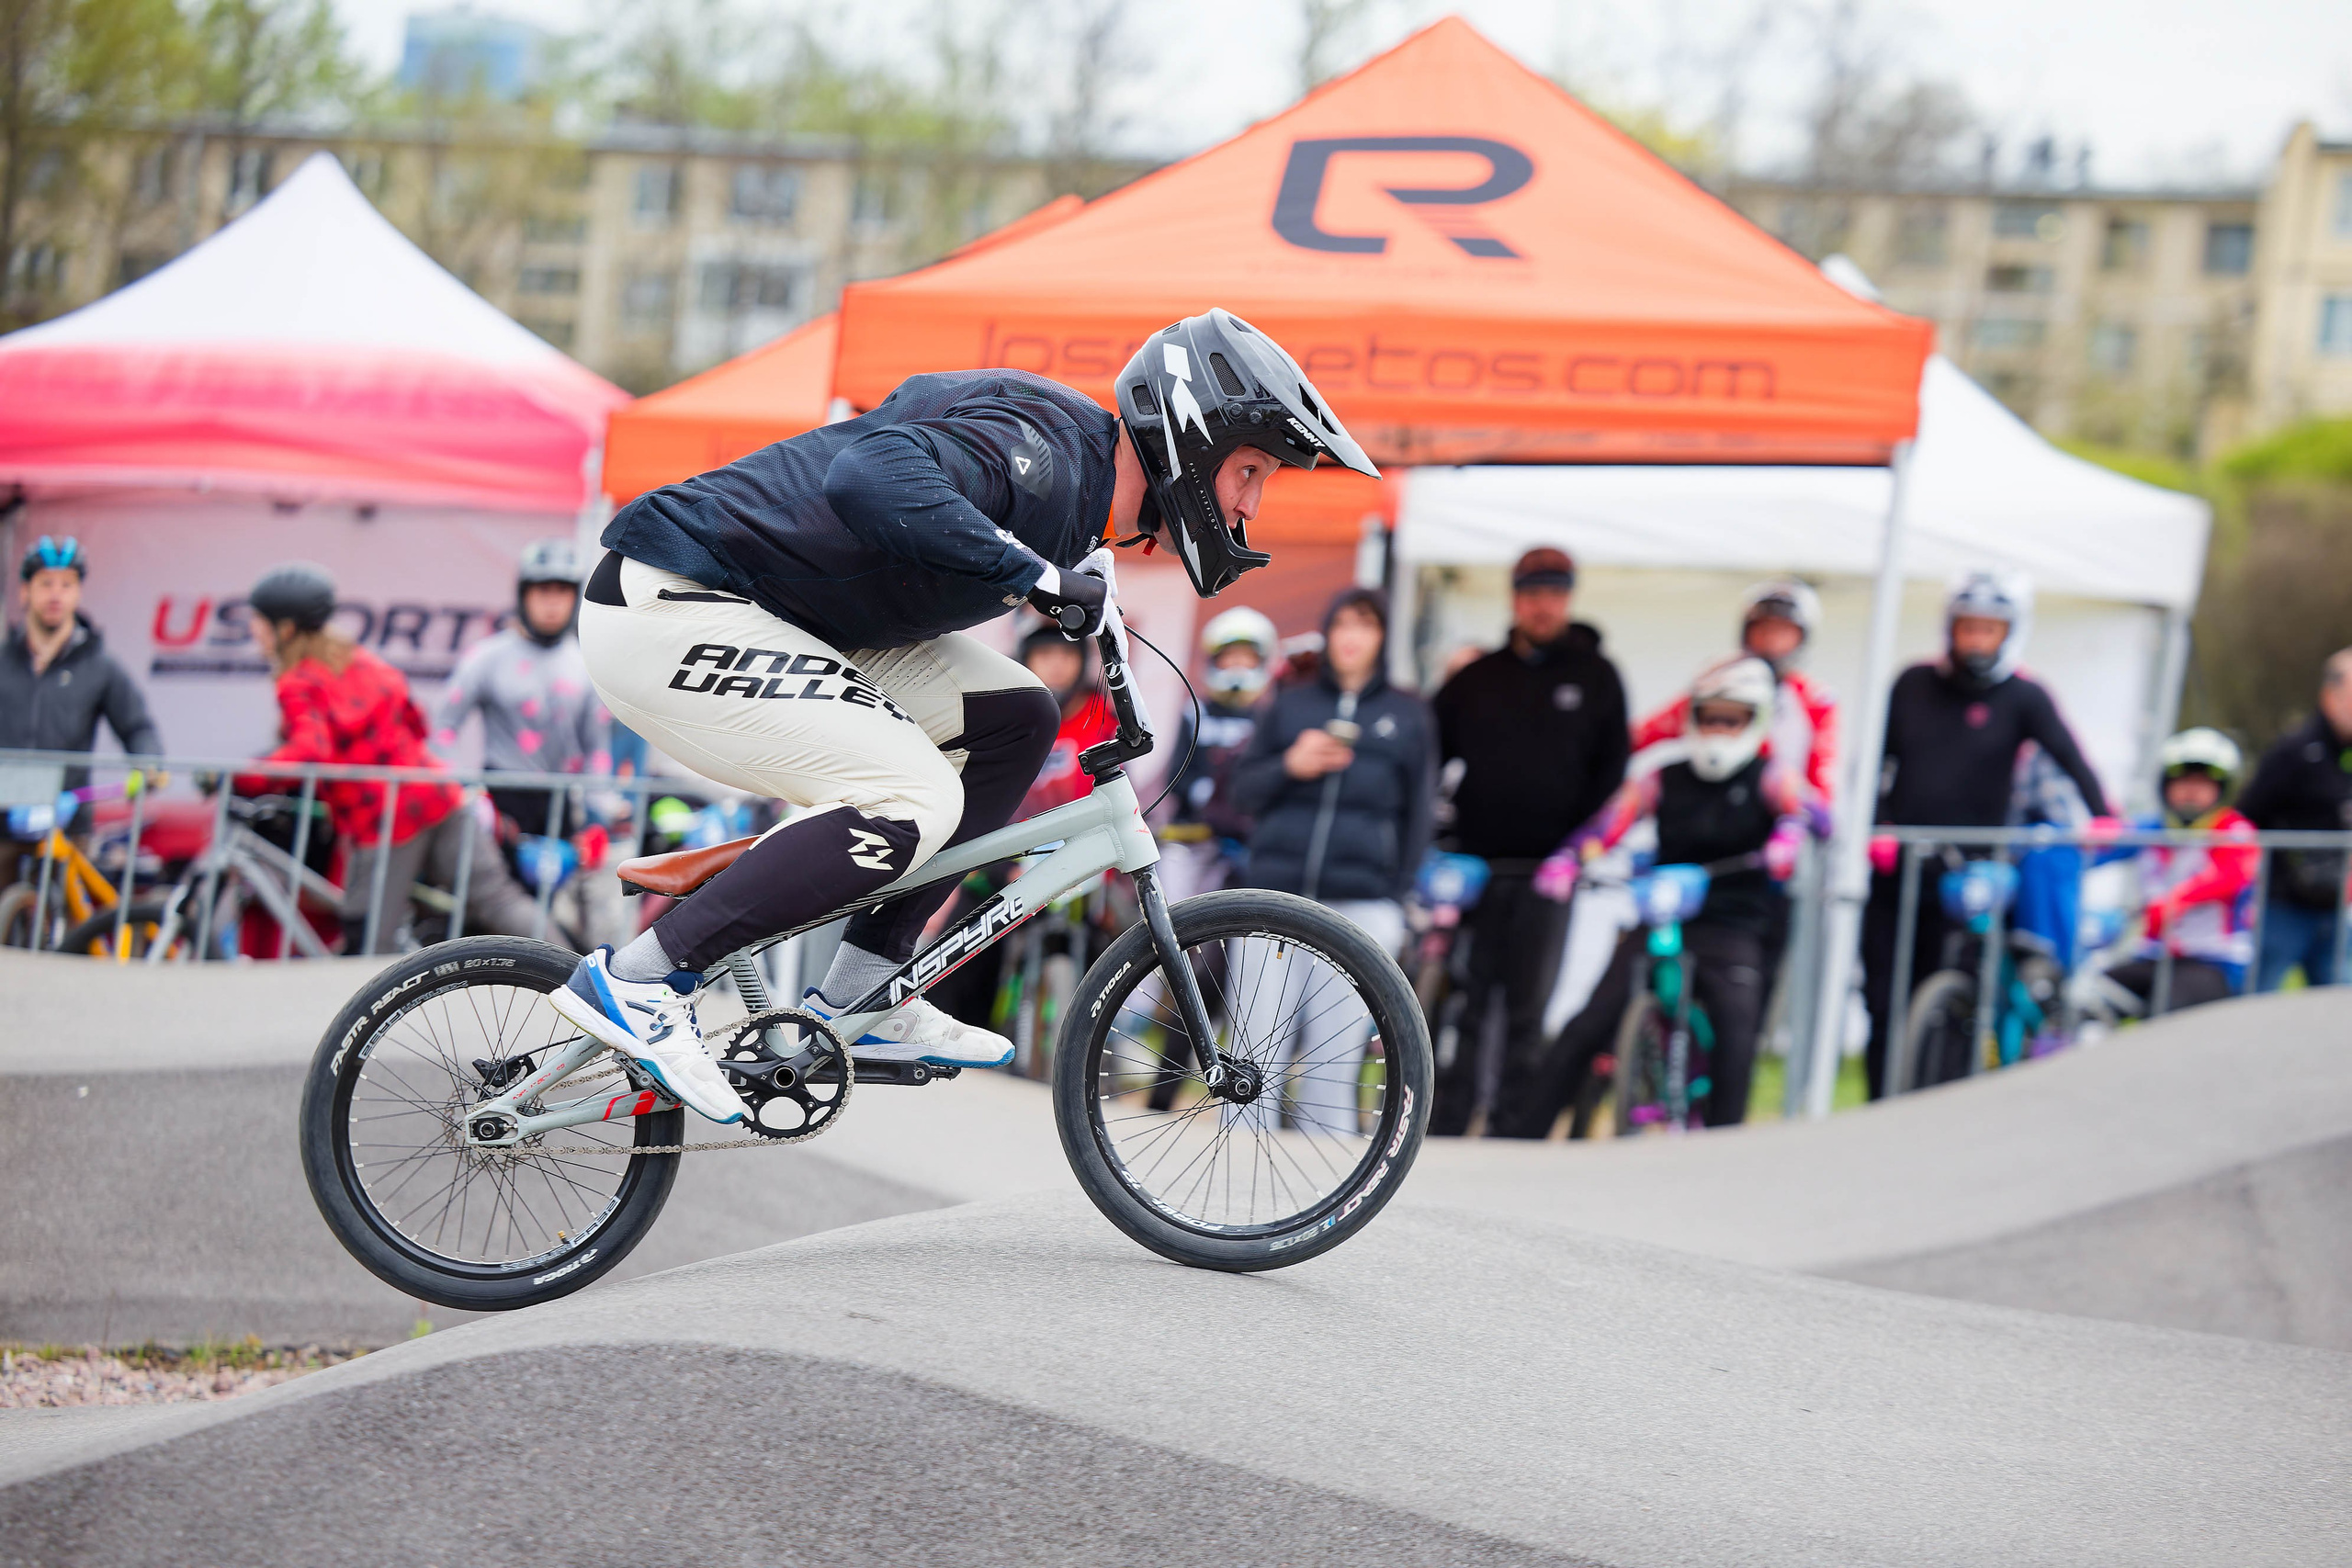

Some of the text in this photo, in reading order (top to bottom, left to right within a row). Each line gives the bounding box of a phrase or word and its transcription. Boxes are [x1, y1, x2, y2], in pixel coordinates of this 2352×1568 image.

[1286, 417, 1326, 447] KENNY
[681, 643, 884, 694] ANDE
[1099, 961, 1132, 1001] TIOGA
[1249, 931, 1359, 987] FORWARD
[330, 970, 430, 1077] FASTR REACT
[1338, 1084, 1414, 1222] FASTR REACT
